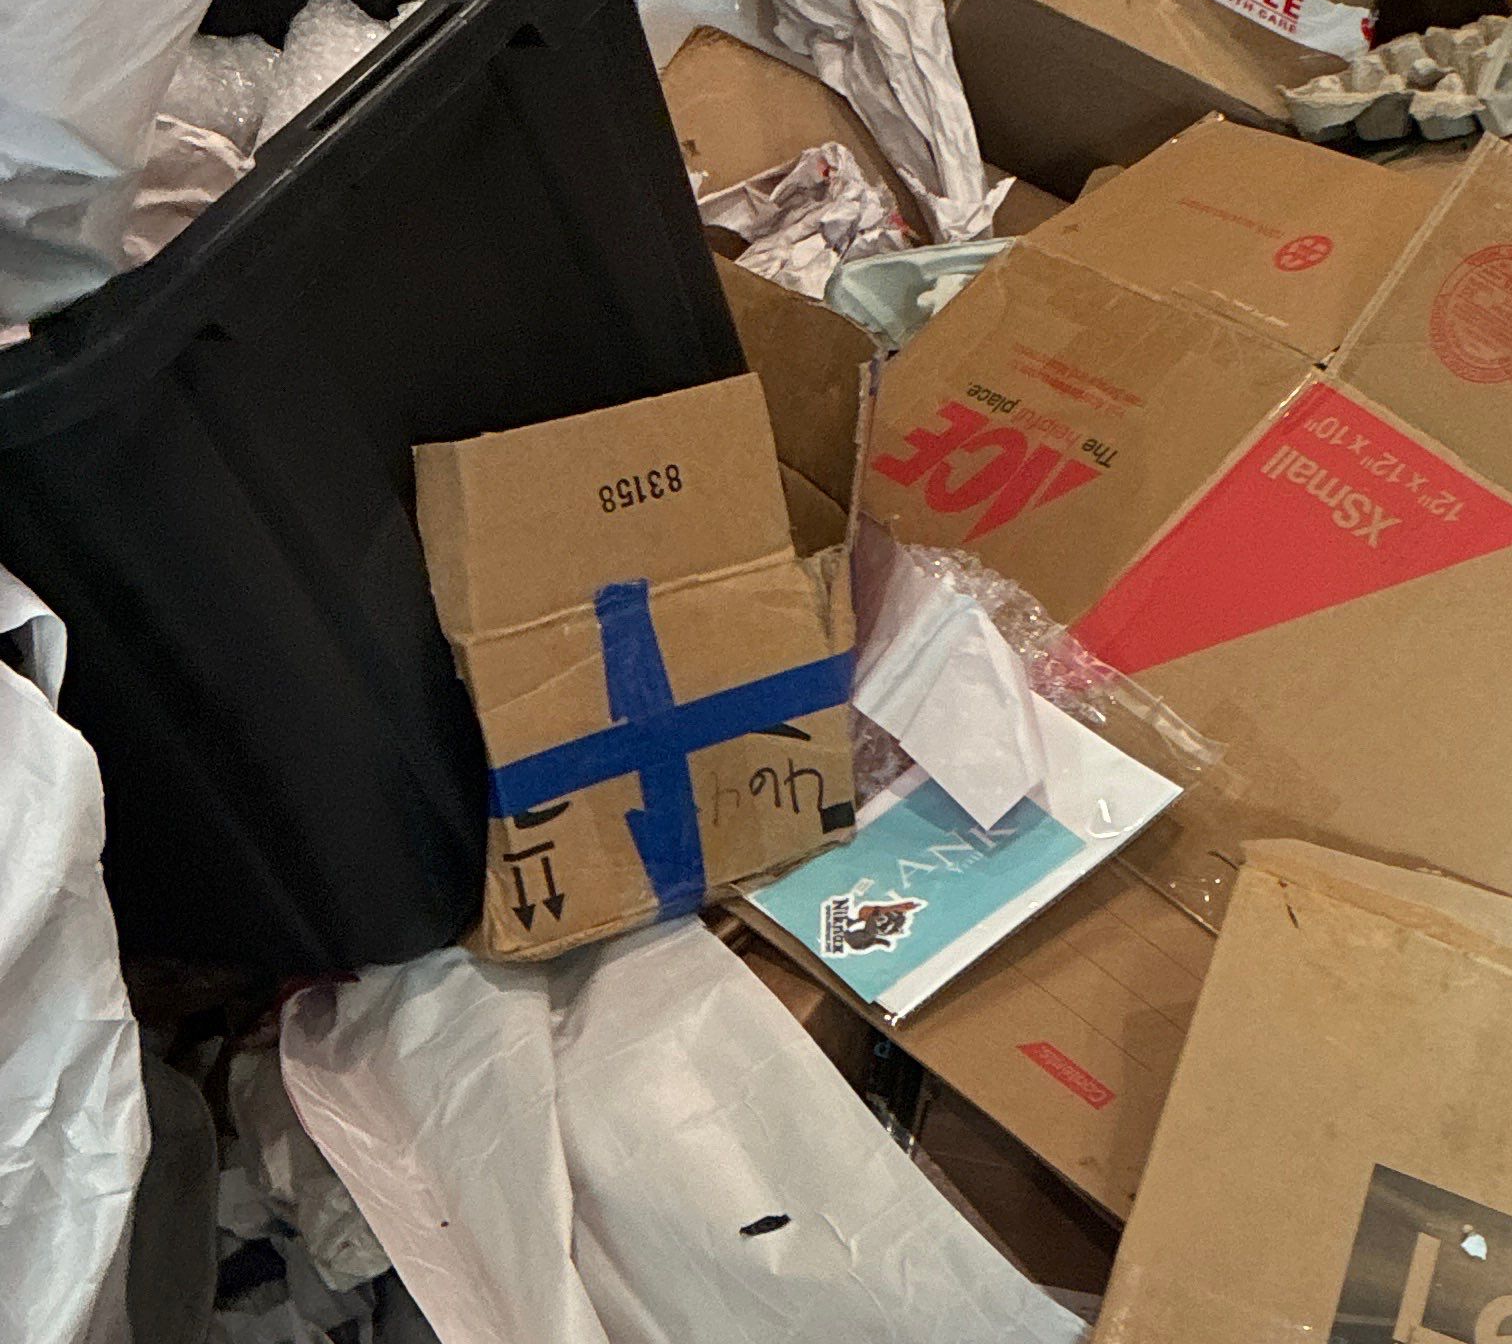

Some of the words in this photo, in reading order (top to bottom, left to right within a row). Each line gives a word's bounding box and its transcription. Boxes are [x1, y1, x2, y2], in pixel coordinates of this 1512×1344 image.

[1258, 8, 1298, 34] CARE
[966, 381, 1022, 415] place.
[1012, 406, 1084, 450] helpful
[1303, 416, 1350, 446] 10"
[1081, 437, 1120, 468] The
[1359, 452, 1407, 483] 12"
[600, 463, 684, 514] 83158
[870, 400, 1102, 545] ACE
[1259, 444, 1404, 549] XSmall
[1416, 490, 1465, 522] 12"
